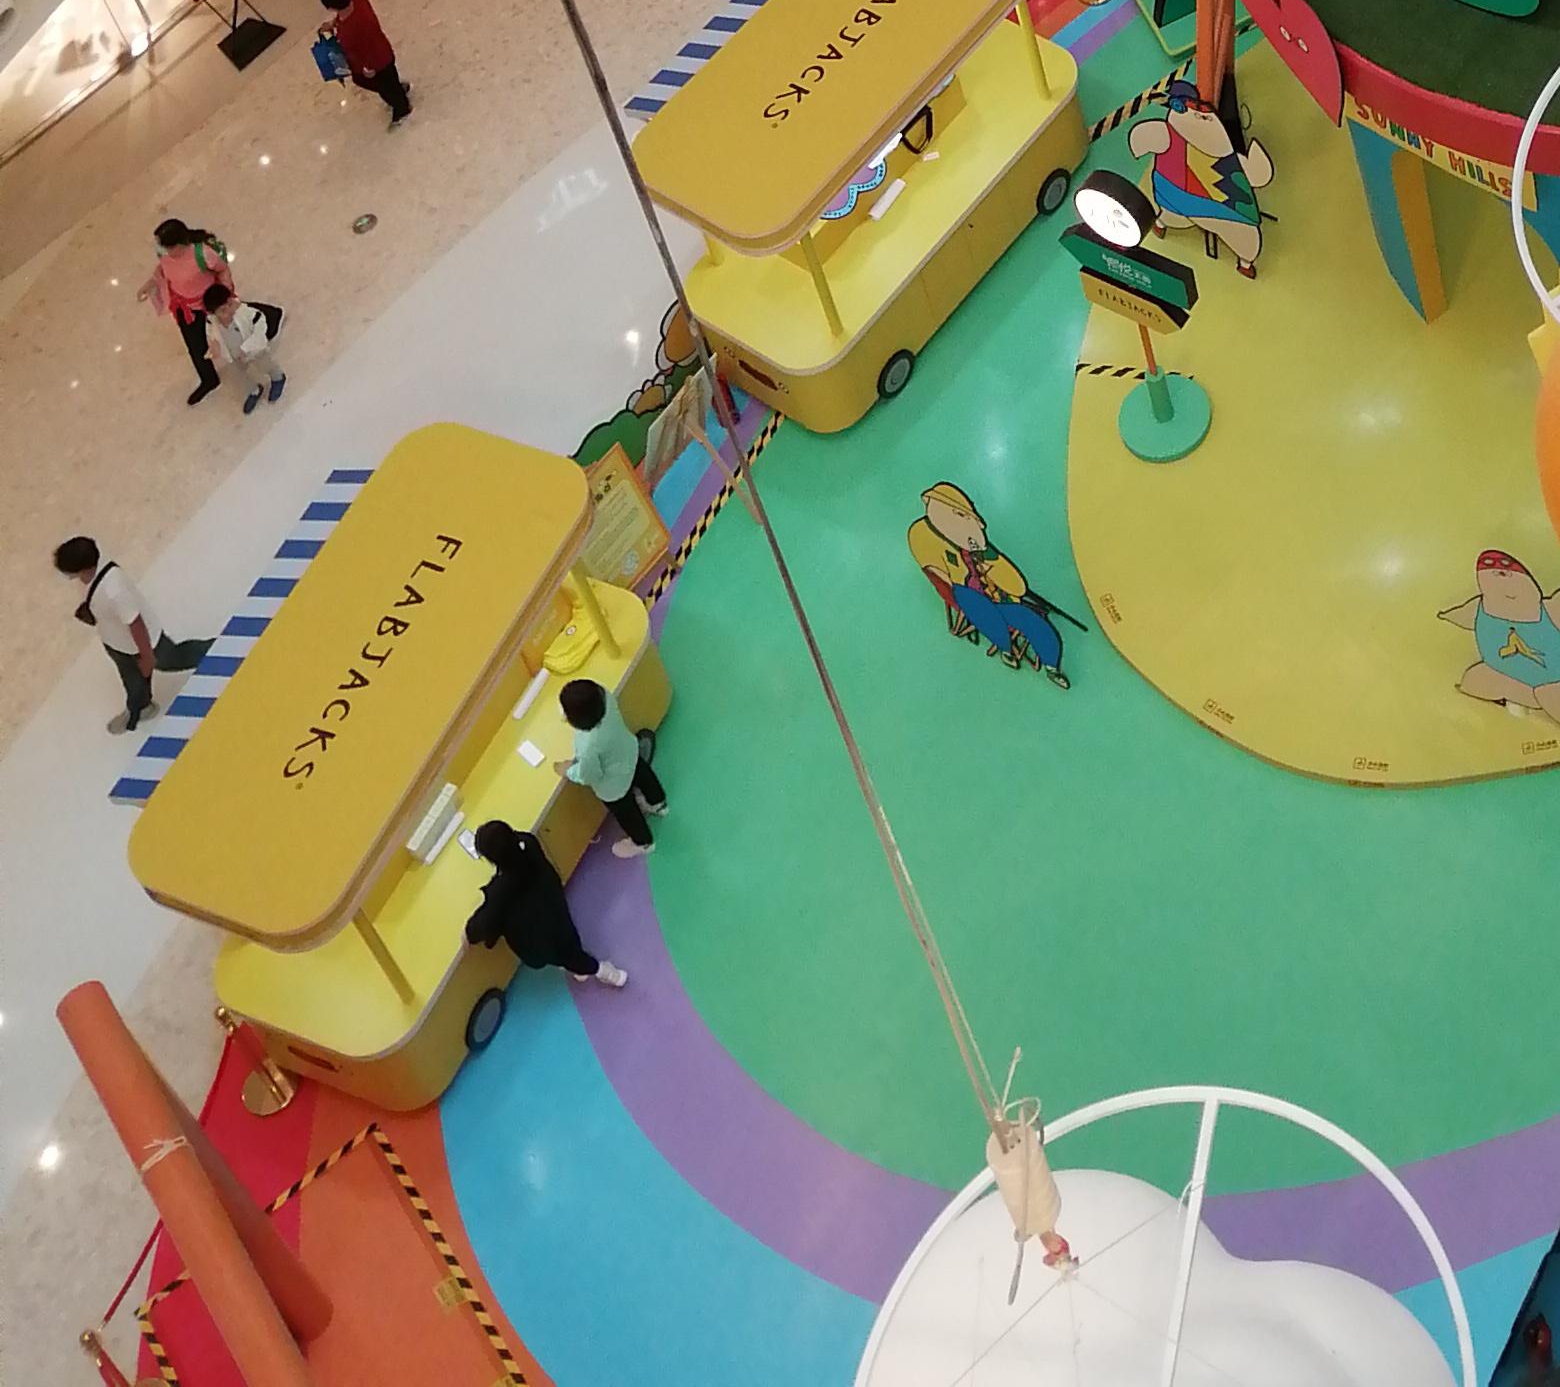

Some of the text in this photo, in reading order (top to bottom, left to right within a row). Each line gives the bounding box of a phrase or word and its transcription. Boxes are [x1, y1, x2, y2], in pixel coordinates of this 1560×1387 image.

[1353, 95, 1513, 199] SUNNY HILLS
[281, 533, 464, 779] FLABJACKS
